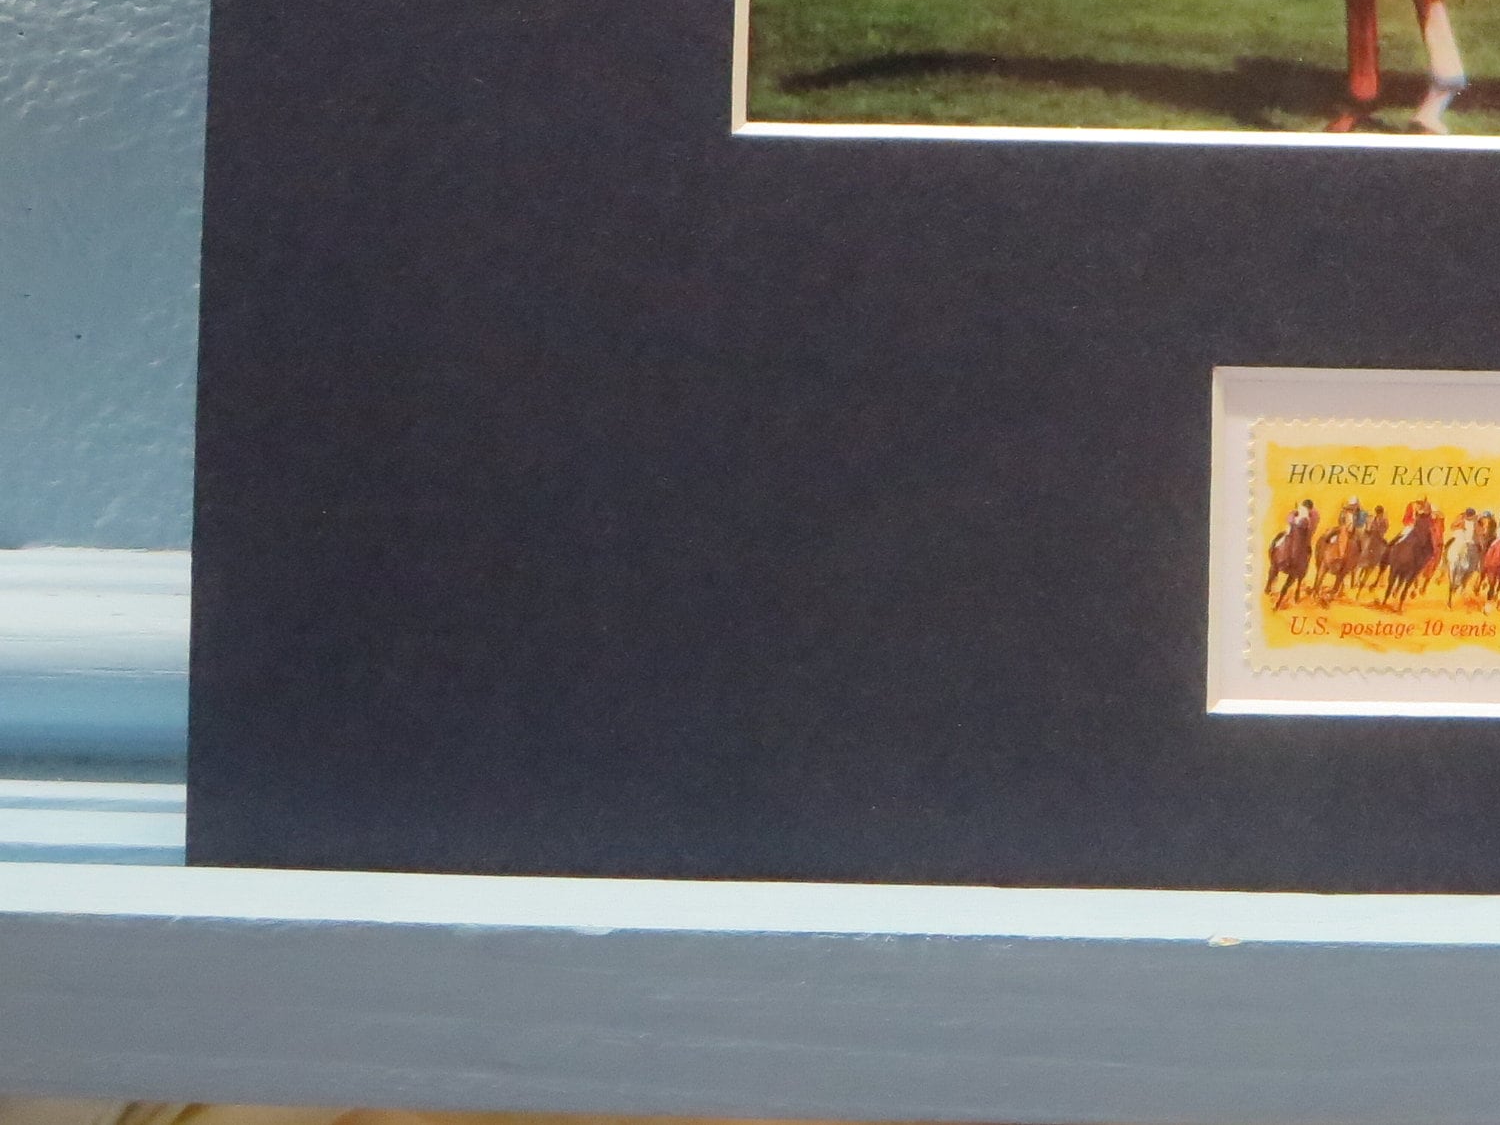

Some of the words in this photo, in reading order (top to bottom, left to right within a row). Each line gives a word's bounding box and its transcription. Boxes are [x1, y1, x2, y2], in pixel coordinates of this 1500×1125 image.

[1288, 464, 1379, 486] HORSE
[1391, 465, 1492, 487] RACING
[1290, 616, 1330, 636] U.S.
[1340, 619, 1415, 639] postage
[1422, 618, 1443, 637] 10
[1450, 620, 1497, 637] cents
